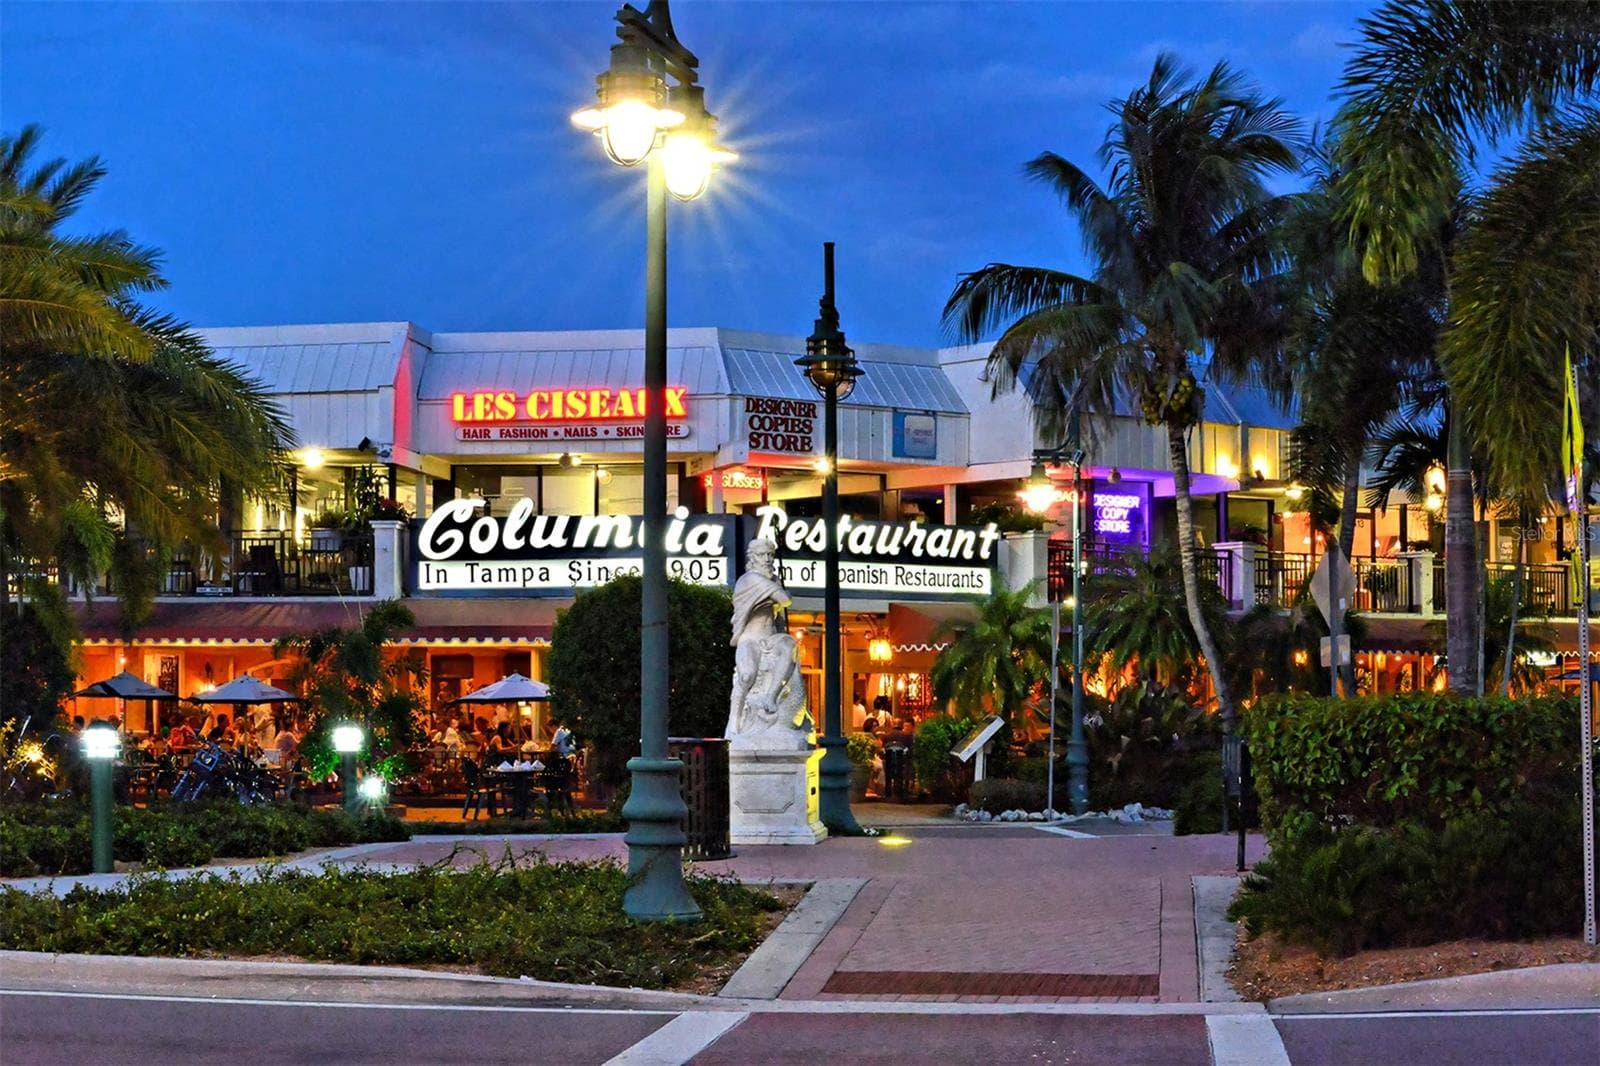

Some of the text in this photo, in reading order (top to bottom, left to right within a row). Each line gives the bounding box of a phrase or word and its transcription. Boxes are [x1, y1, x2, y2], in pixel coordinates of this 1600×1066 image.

[453, 392, 516, 421] LES
[745, 397, 817, 418] DESIGNER
[463, 428, 491, 439] HAIR
[500, 427, 548, 438] FASHION
[564, 427, 598, 437] NAILS
[616, 426, 644, 437] SKIN
[749, 414, 813, 434] COPIES
[749, 432, 813, 451] STORE
[418, 497, 724, 560] Columia
[756, 505, 1000, 559] Restaurant
[425, 563, 448, 584] In
[465, 562, 550, 587] Tampa
[671, 559, 720, 581] 905
[801, 561, 816, 582] of
[837, 564, 888, 586] panish
[895, 565, 984, 589] Restaurants
